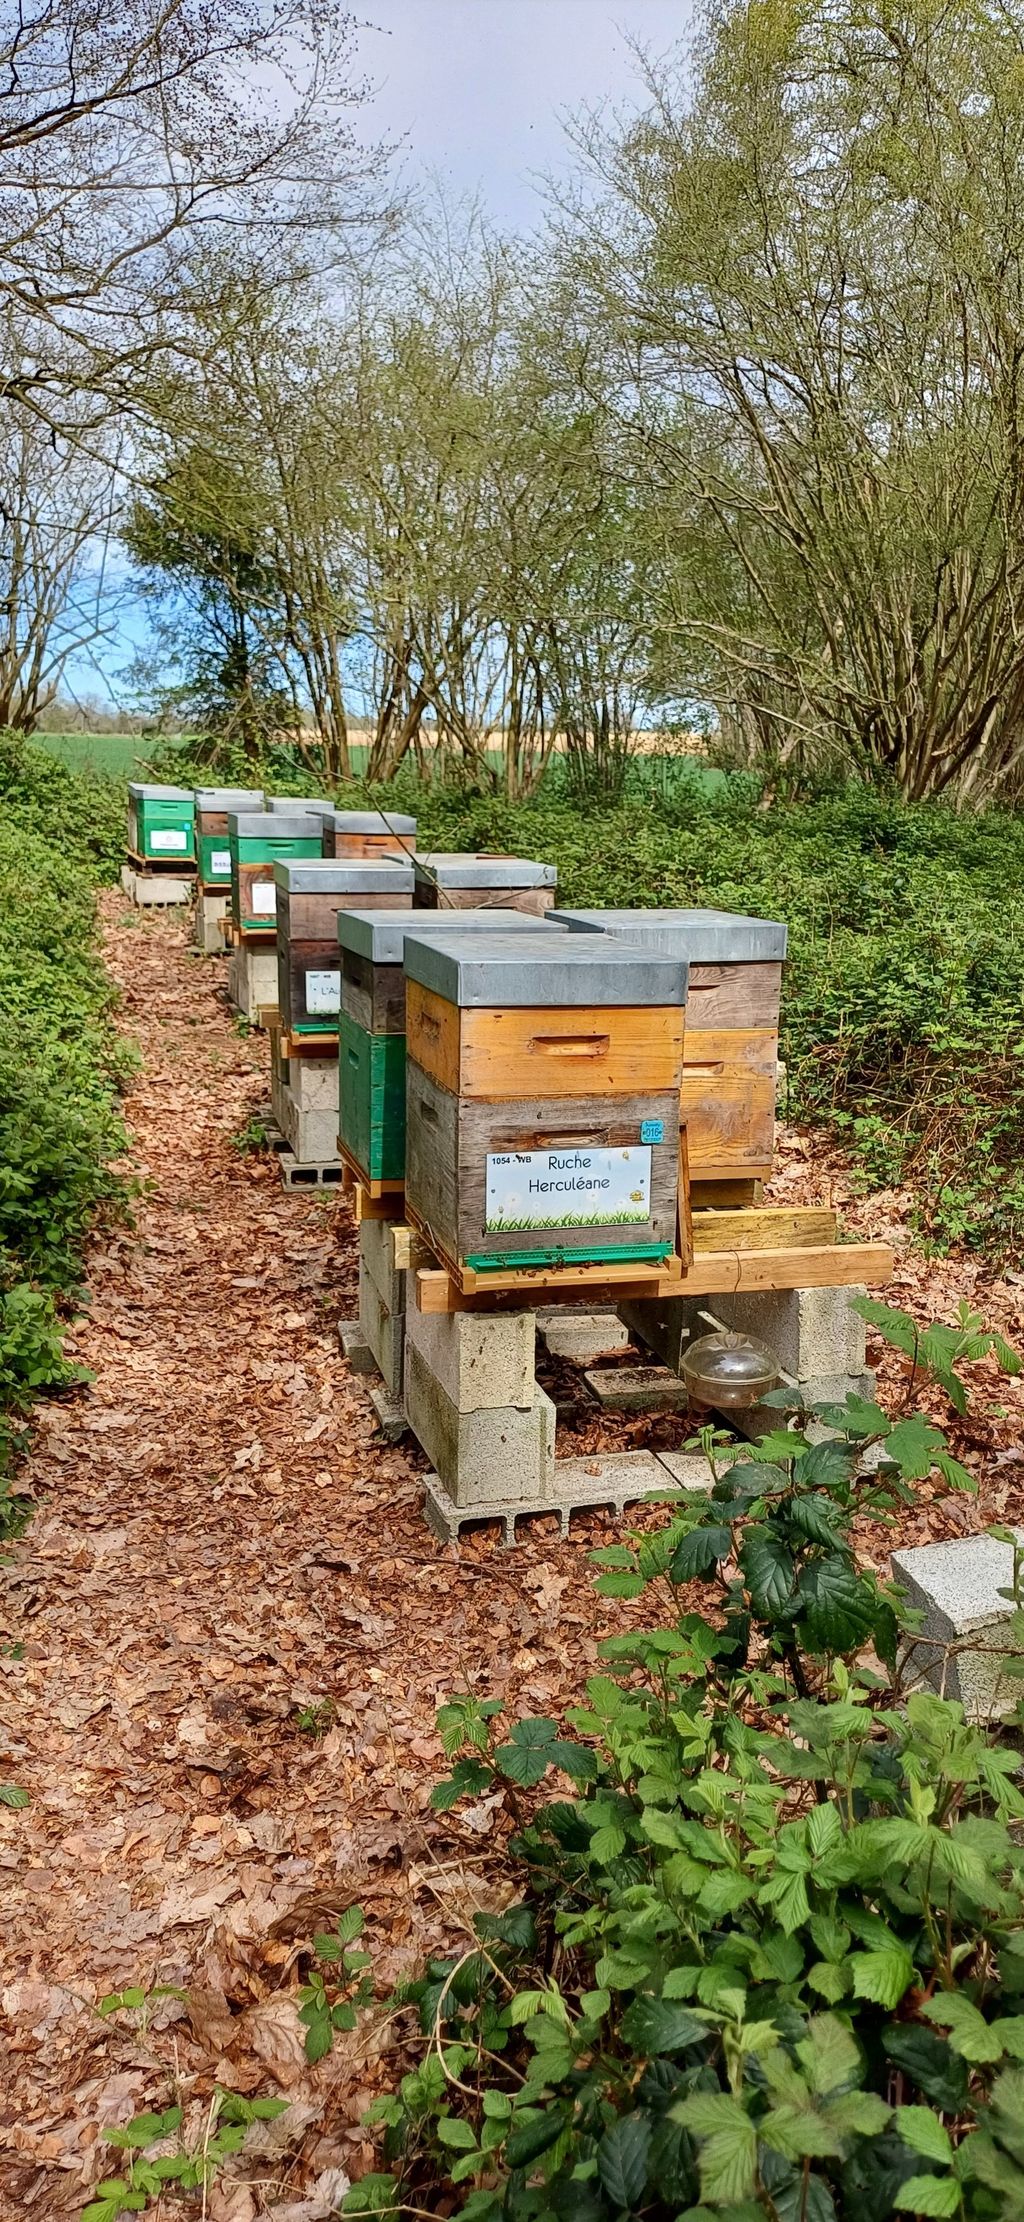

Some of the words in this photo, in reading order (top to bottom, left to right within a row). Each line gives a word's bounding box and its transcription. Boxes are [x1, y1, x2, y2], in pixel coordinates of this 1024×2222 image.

[492, 1157, 510, 1165] 1054
[548, 1155, 592, 1170] Ruche
[529, 1176, 610, 1193] Herculéane
